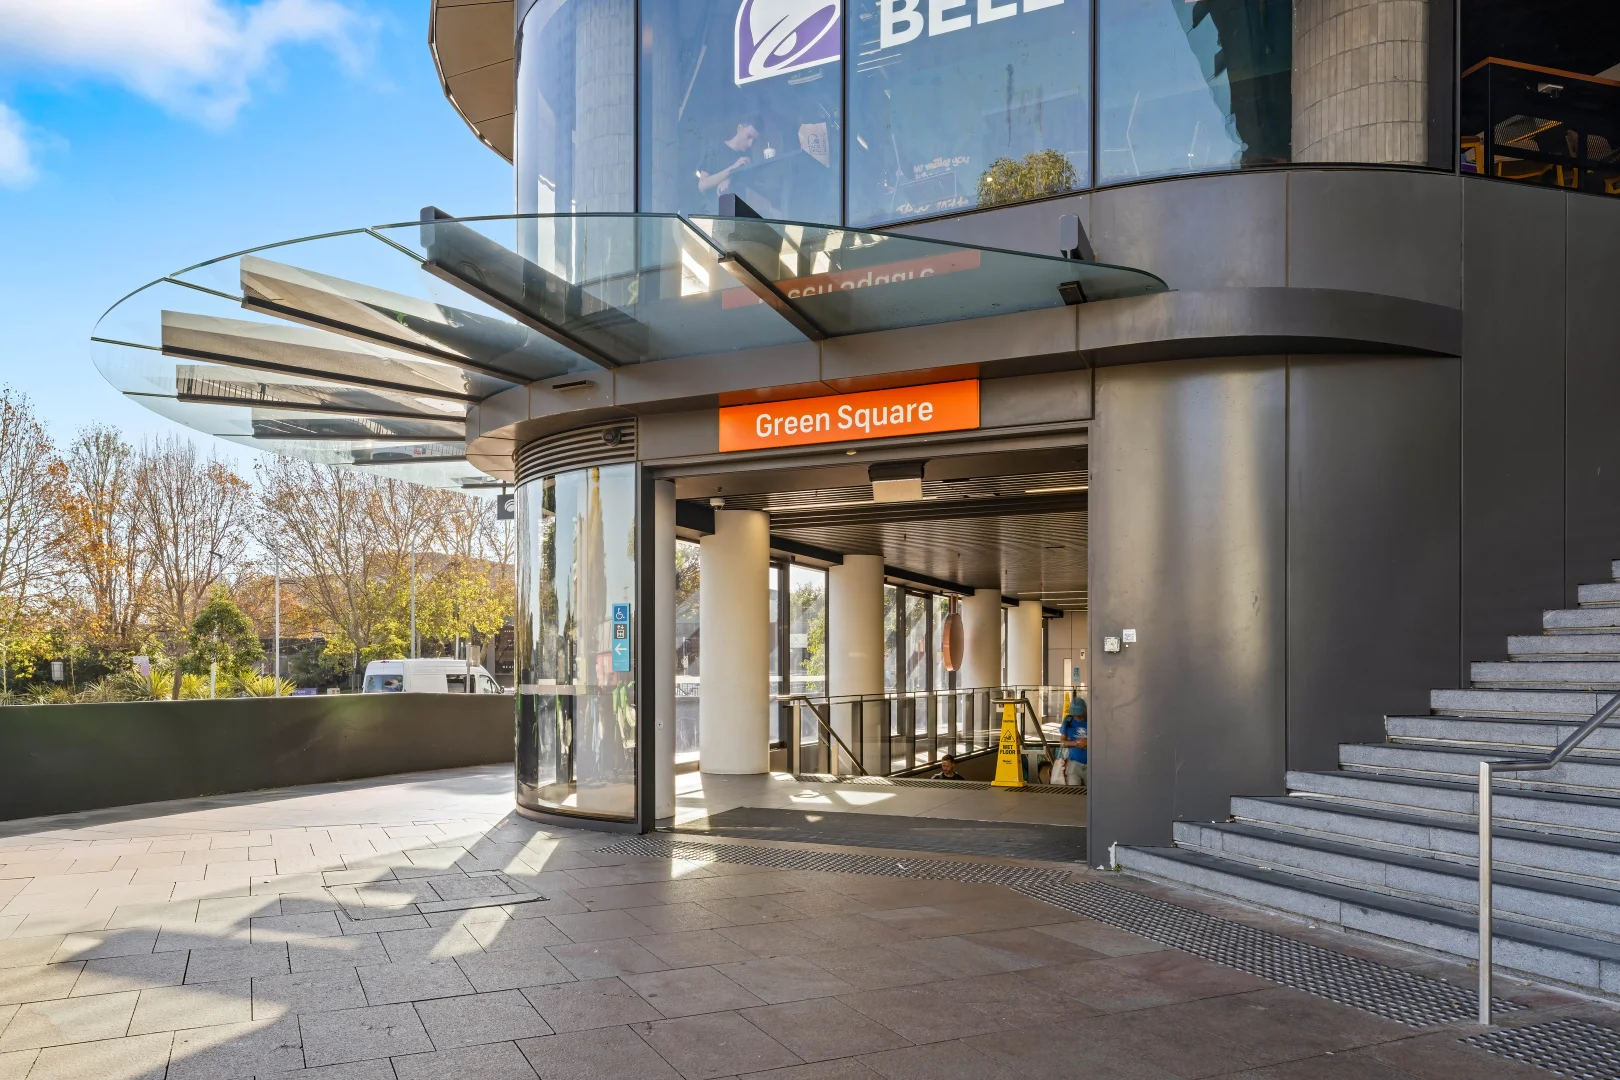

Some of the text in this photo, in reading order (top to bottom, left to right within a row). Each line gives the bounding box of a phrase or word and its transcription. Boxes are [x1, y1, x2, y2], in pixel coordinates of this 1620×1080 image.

[880, 0, 1064, 49] BEL
[756, 401, 934, 437] Green Square
